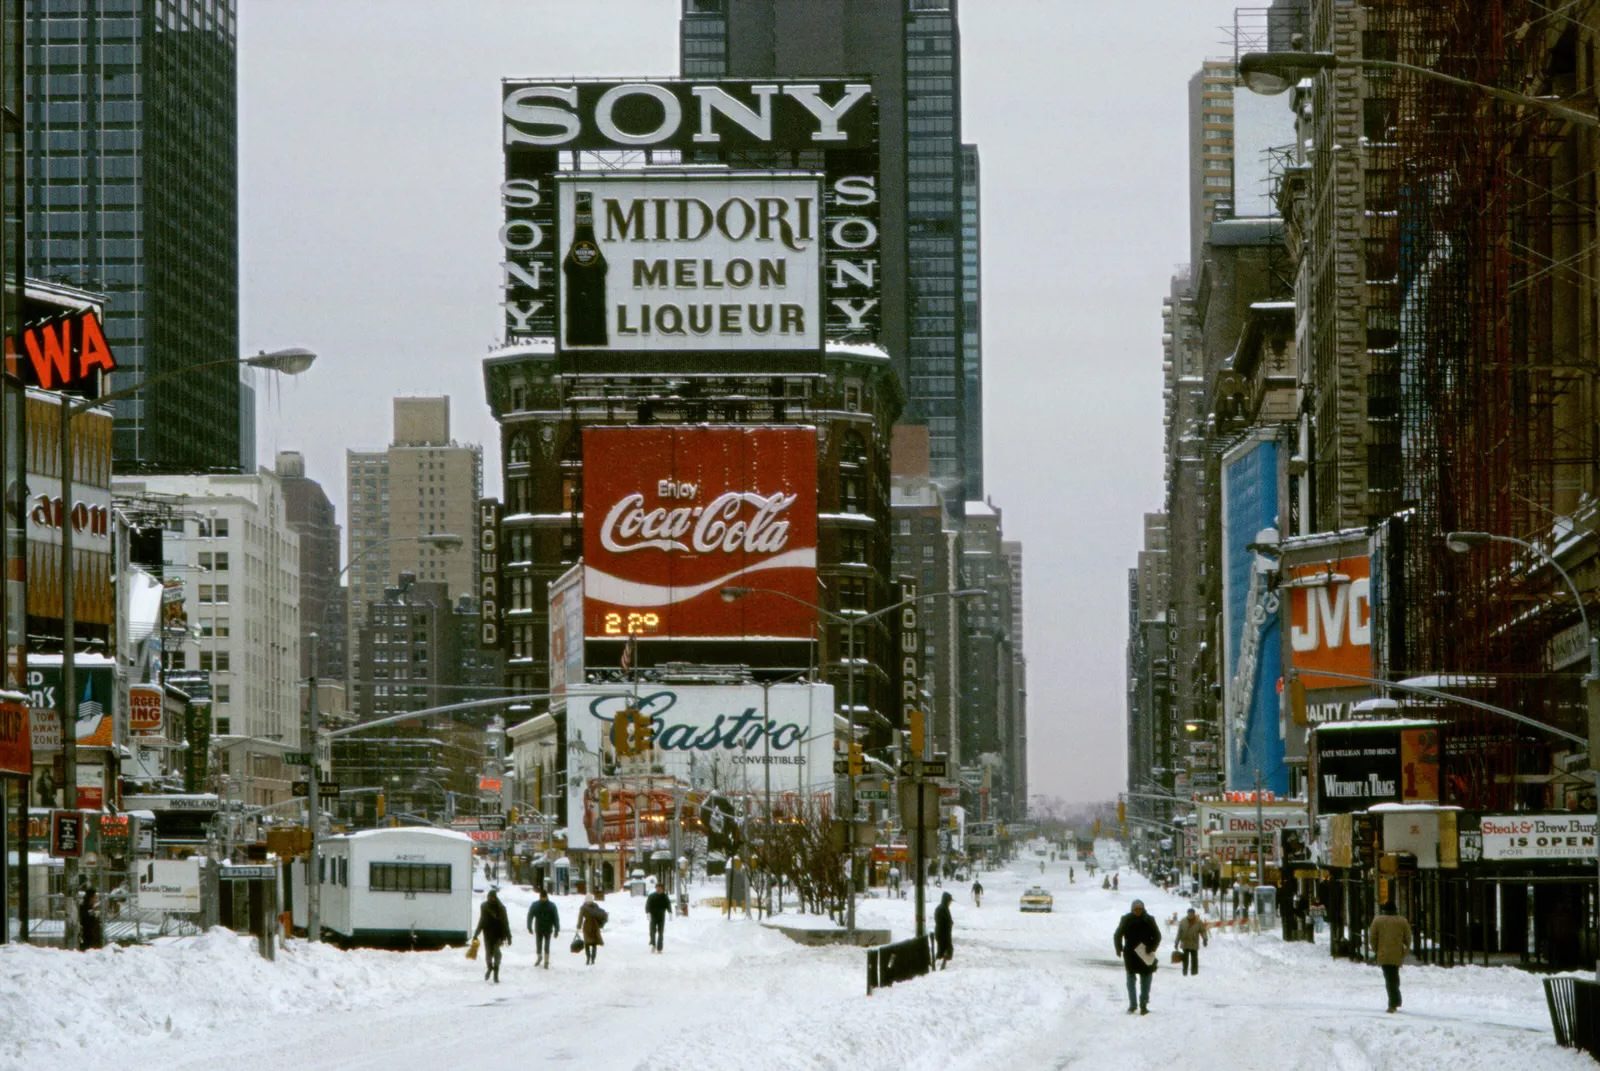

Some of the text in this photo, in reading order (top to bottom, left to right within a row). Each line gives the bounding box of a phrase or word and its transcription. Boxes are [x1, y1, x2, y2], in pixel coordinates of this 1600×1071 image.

[503, 84, 872, 145] SONY
[602, 197, 814, 252] MIDORI
[500, 179, 545, 332] SONY
[831, 176, 879, 330] SONY
[632, 257, 787, 289] MELON
[616, 302, 806, 336] LIQUEUR
[658, 479, 698, 500] Enjoy
[600, 491, 798, 553] Coca-Cola
[481, 505, 497, 645] HOWARD
[1290, 577, 1371, 652] JVC
[32, 724, 59, 733] AWAY
[35, 713, 55, 721] TOW
[588, 691, 809, 751] Castro
[33, 735, 60, 745] ZONE
[732, 756, 807, 765] CONVERTIBLES
[1363, 780, 1370, 798] A
[1483, 821, 1519, 834] Steak
[1519, 820, 1534, 834] &
[1534, 820, 1568, 833] Brew
[1510, 836, 1595, 847] IS OPEN
